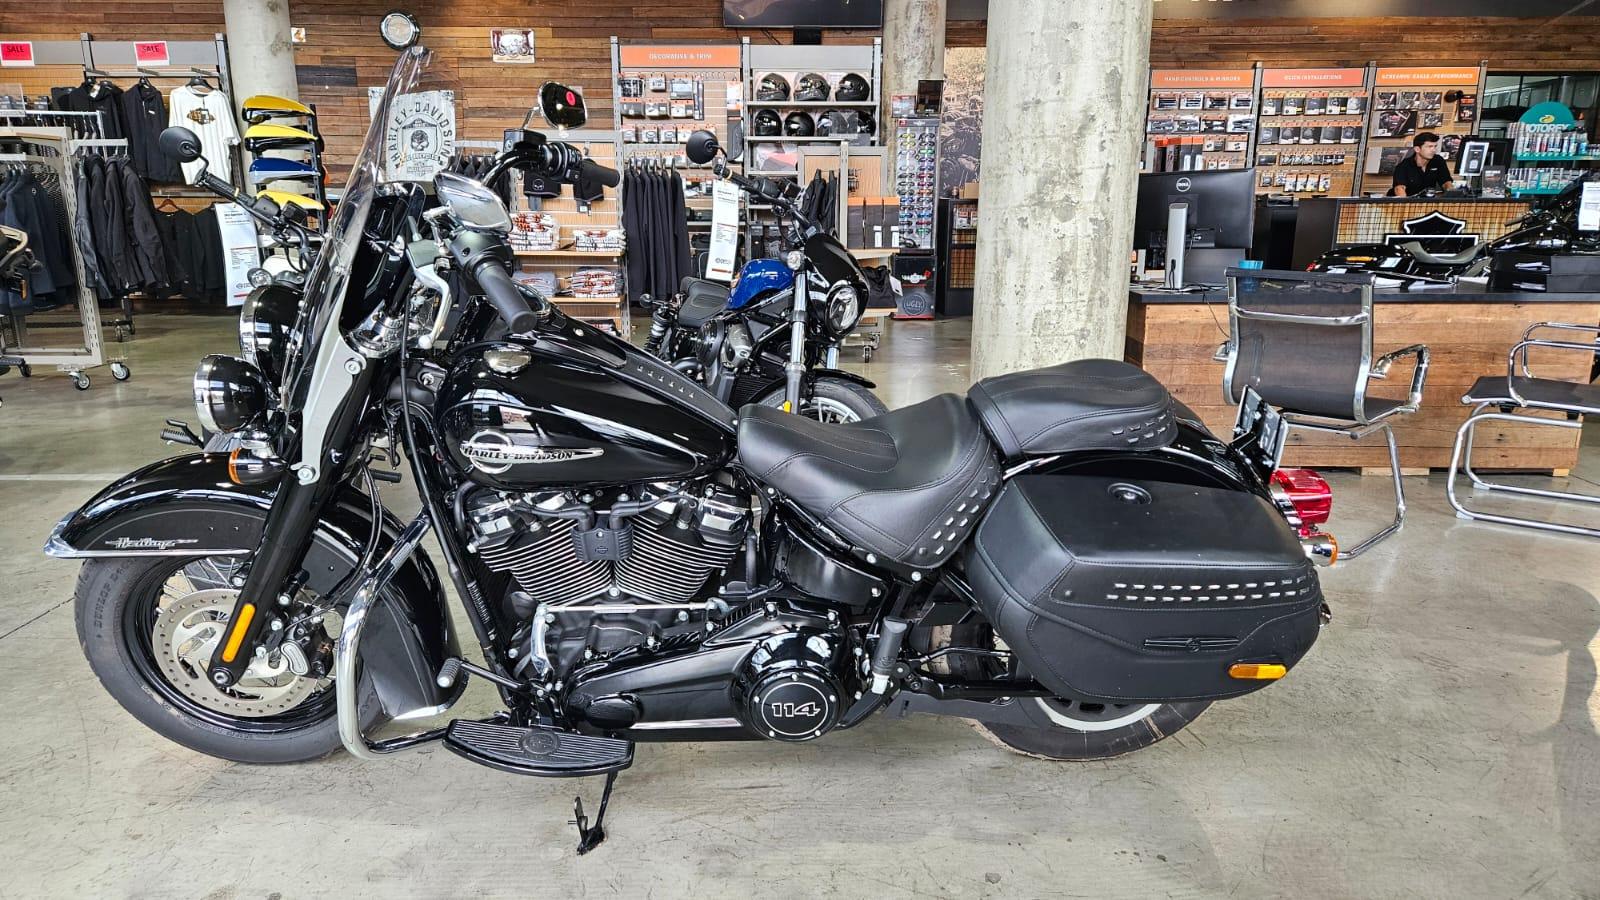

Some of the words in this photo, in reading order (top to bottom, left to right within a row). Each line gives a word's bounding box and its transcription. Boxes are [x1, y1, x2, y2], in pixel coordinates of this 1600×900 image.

[6, 45, 25, 53] SALE
[142, 45, 160, 53] SALE
[463, 445, 574, 461] HARLEY-DAVIDSON
[115, 537, 176, 550] Heritage
[771, 702, 821, 717] 114
